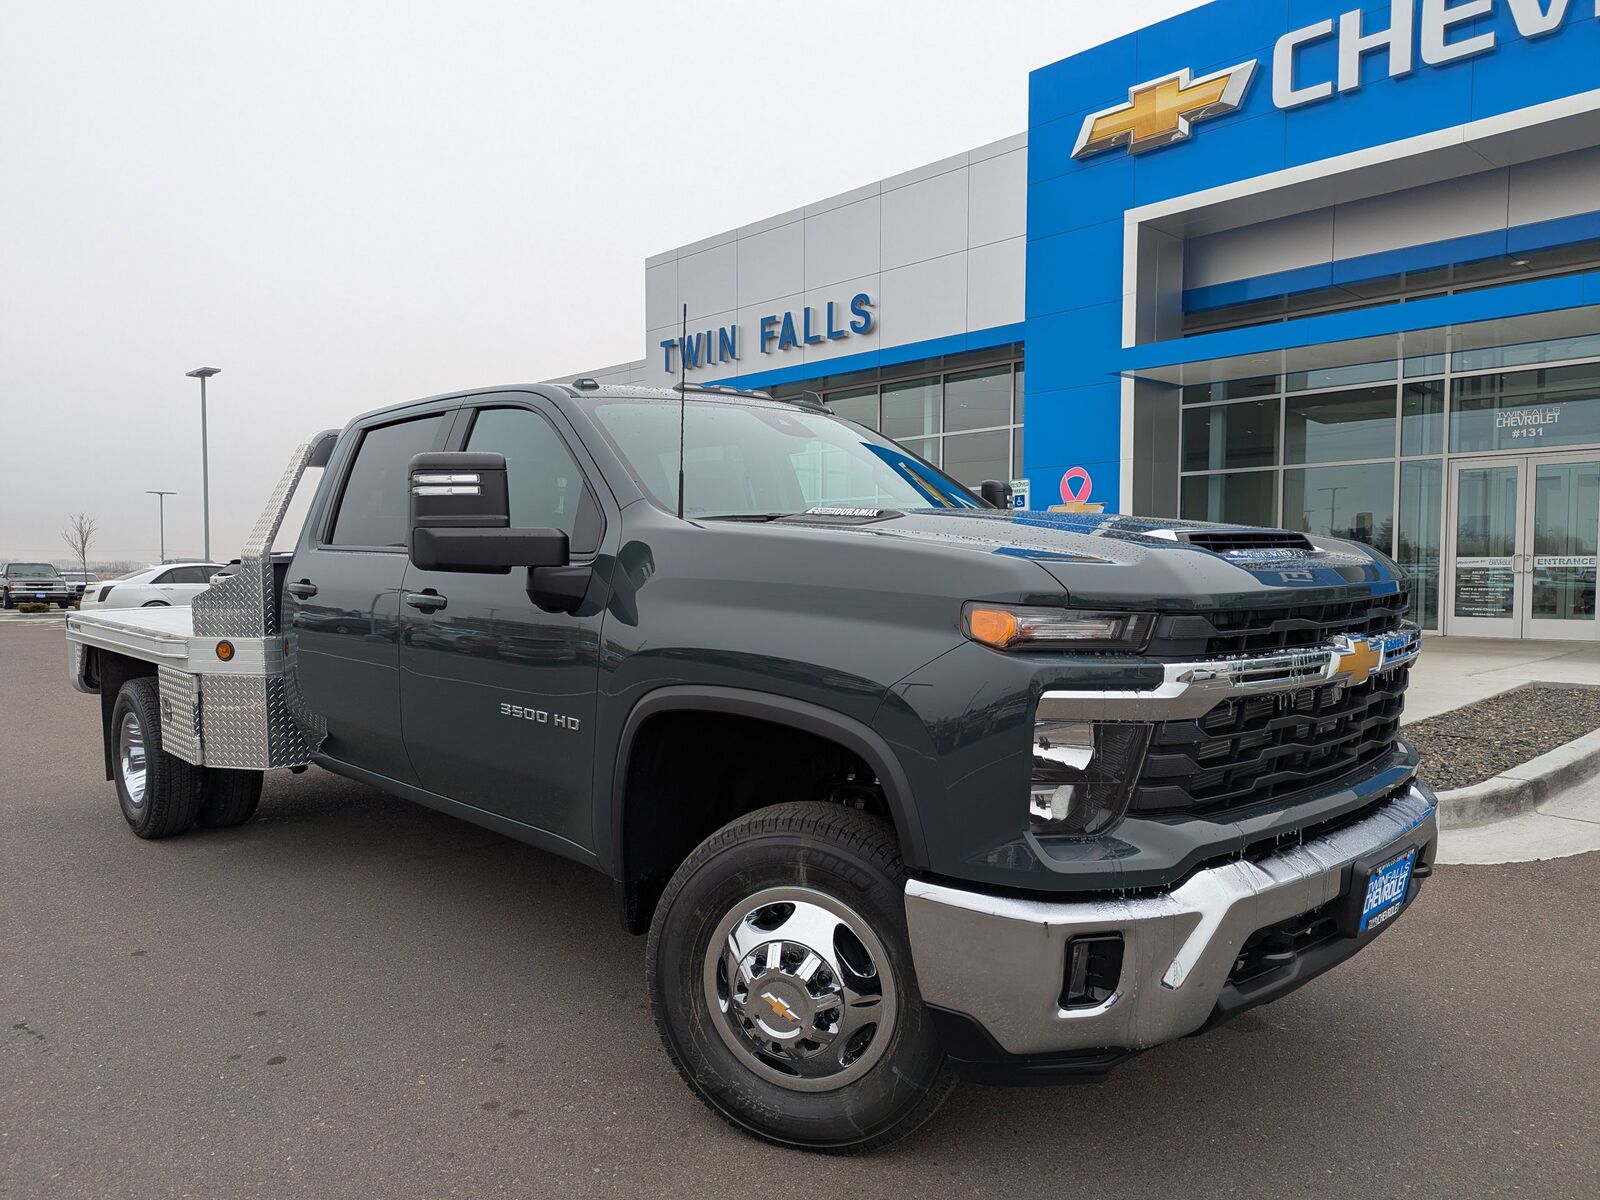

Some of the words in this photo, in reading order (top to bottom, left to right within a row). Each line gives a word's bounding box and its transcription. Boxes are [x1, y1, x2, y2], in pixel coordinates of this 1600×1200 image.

[660, 325, 740, 374] TWIN
[760, 293, 876, 354] FALLS
[1496, 413, 1559, 428] CHEVROLET
[1512, 427, 1544, 438] #131
[833, 508, 881, 517] DURAMAX
[1537, 557, 1596, 565] ENTRANCE
[500, 702, 548, 724] 3500
[553, 713, 580, 731] HD
[1363, 873, 1408, 914] CHEVROLET
